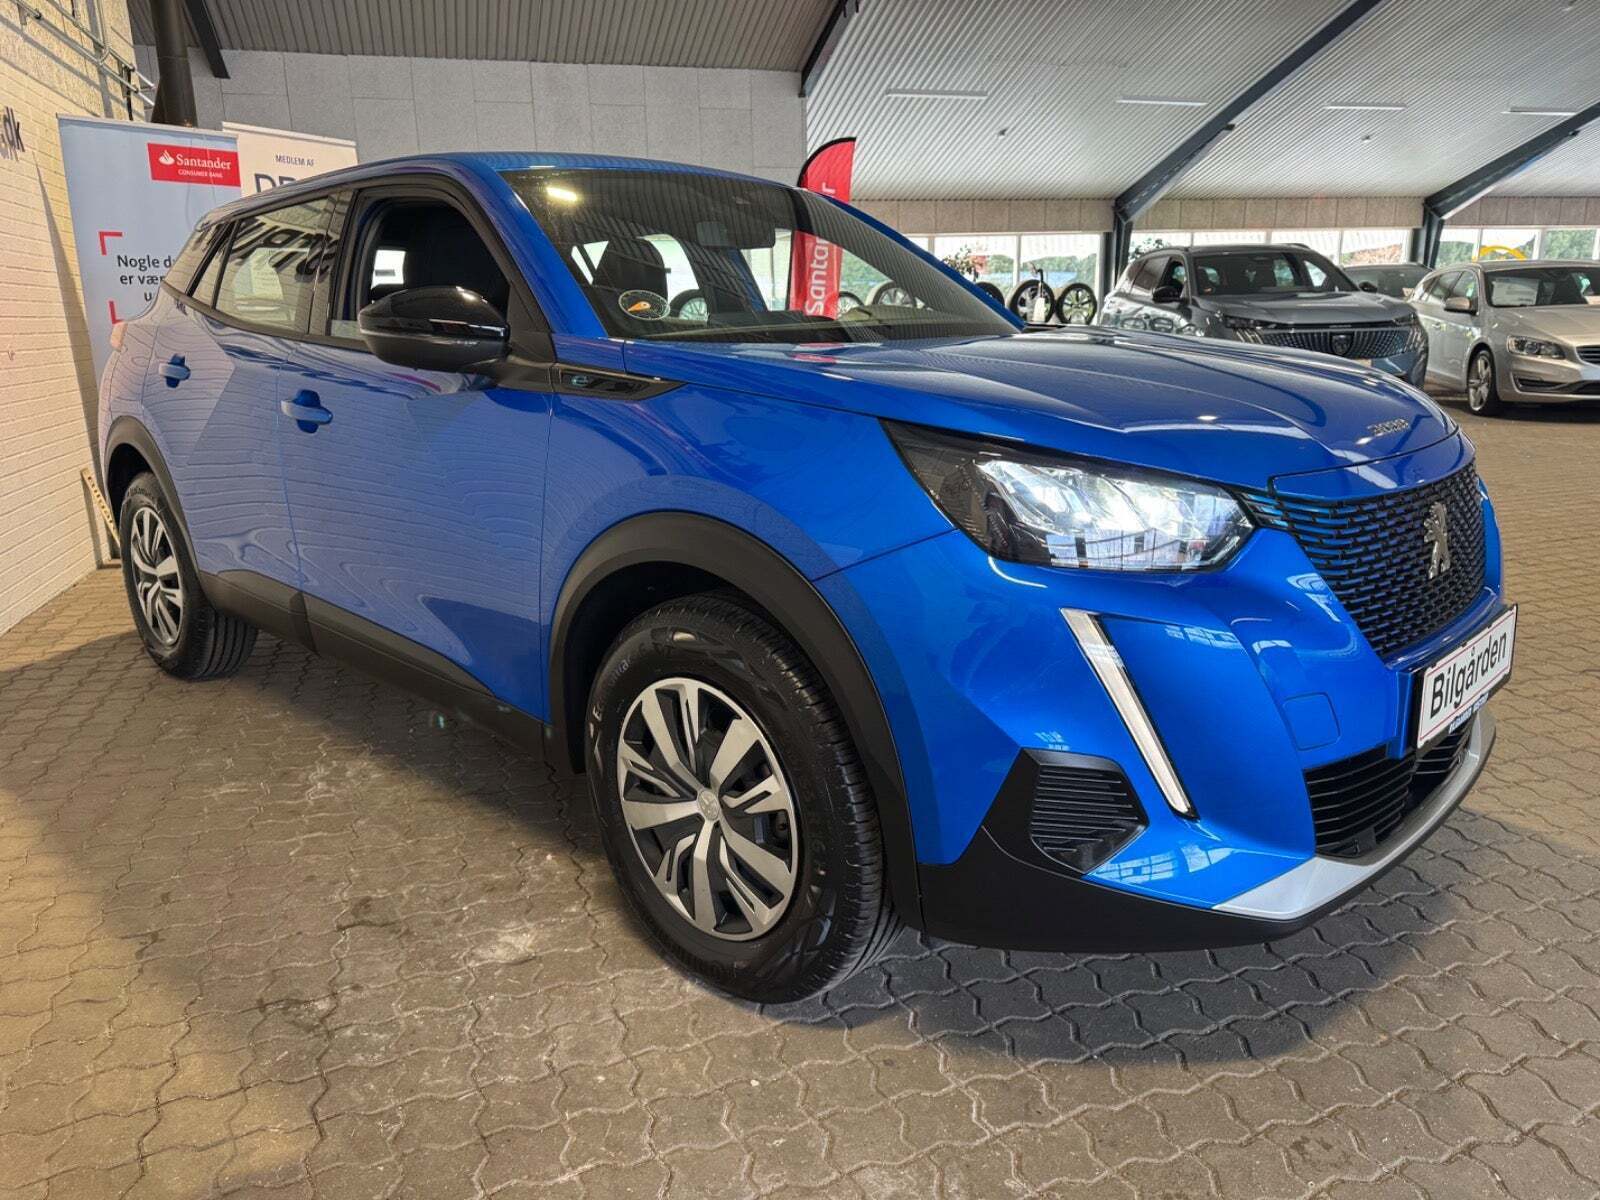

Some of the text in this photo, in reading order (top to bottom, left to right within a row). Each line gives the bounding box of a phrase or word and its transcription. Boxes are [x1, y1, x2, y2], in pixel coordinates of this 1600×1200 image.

[175, 153, 231, 170] Santander
[275, 154, 305, 166] MEDLEM
[177, 168, 208, 177] CONSUMER
[117, 254, 160, 272] Nogle
[119, 275, 134, 285] er
[1430, 632, 1507, 719] Bilgården
